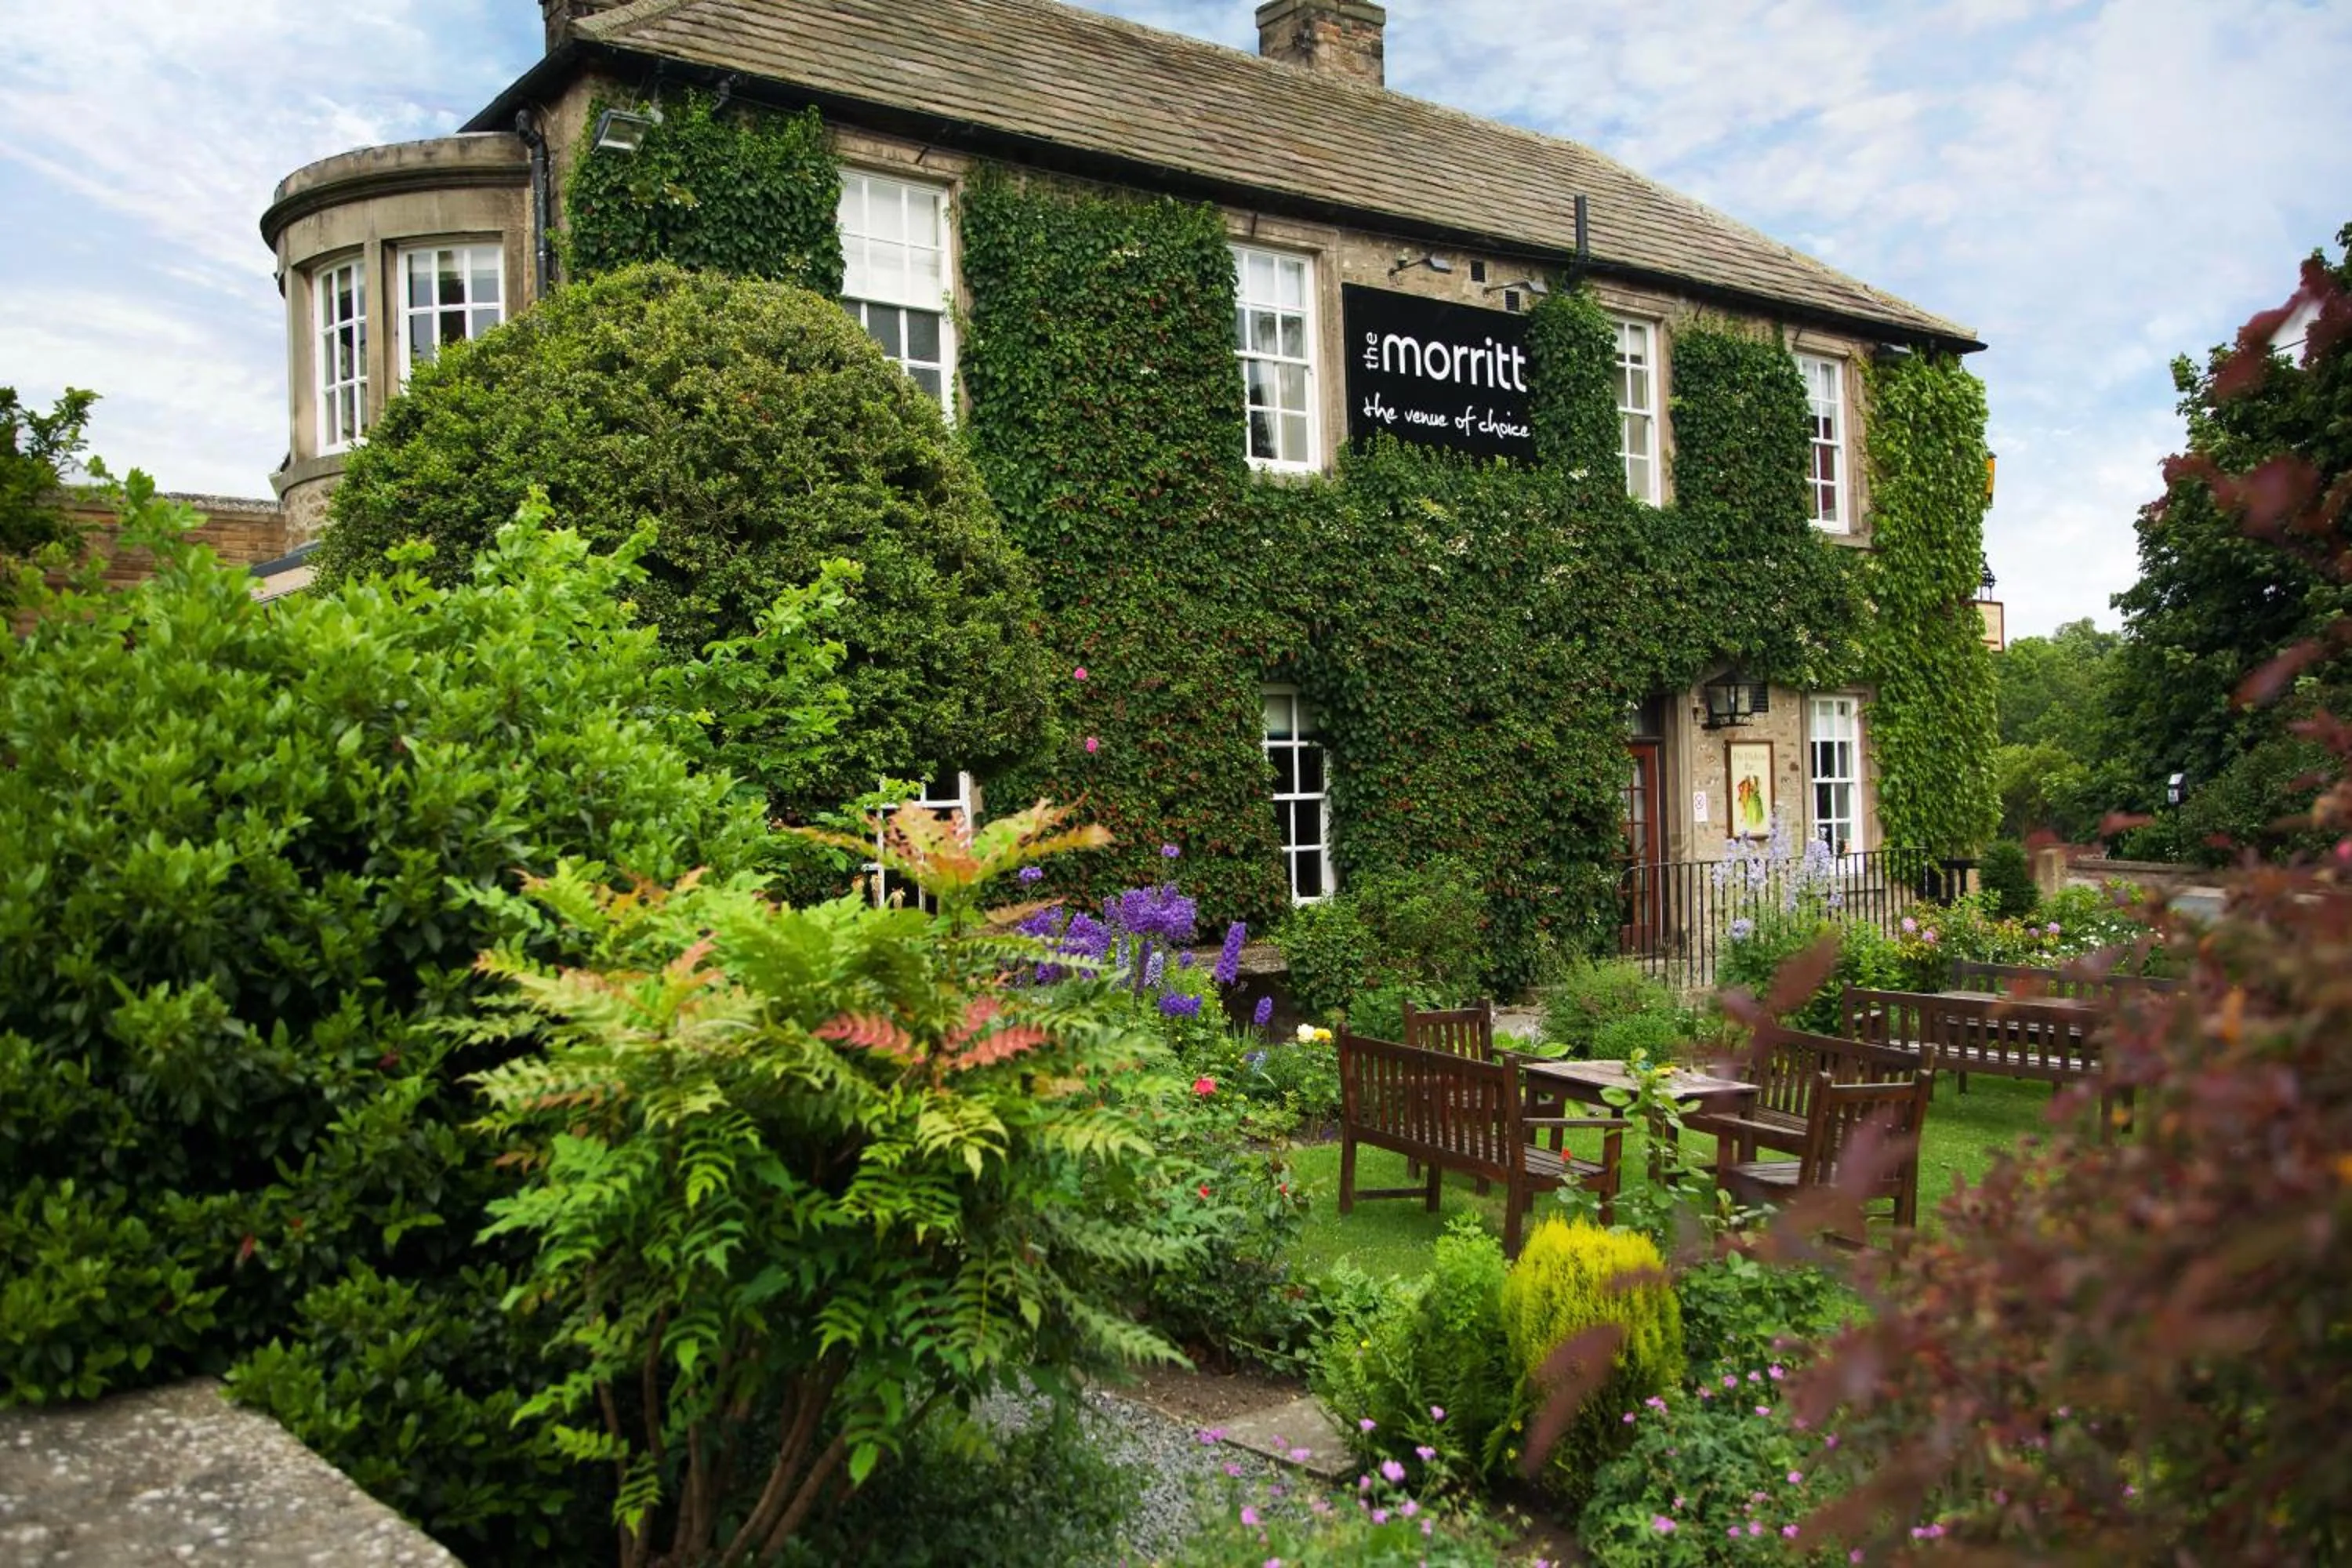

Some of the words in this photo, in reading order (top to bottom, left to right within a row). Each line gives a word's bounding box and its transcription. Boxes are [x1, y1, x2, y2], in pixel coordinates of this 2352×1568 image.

[1363, 332, 1379, 370] the
[1382, 333, 1528, 393] morritt
[1363, 391, 1399, 424] the
[1404, 408, 1449, 427] venue
[1454, 405, 1476, 437] of
[1478, 408, 1530, 439] choice
